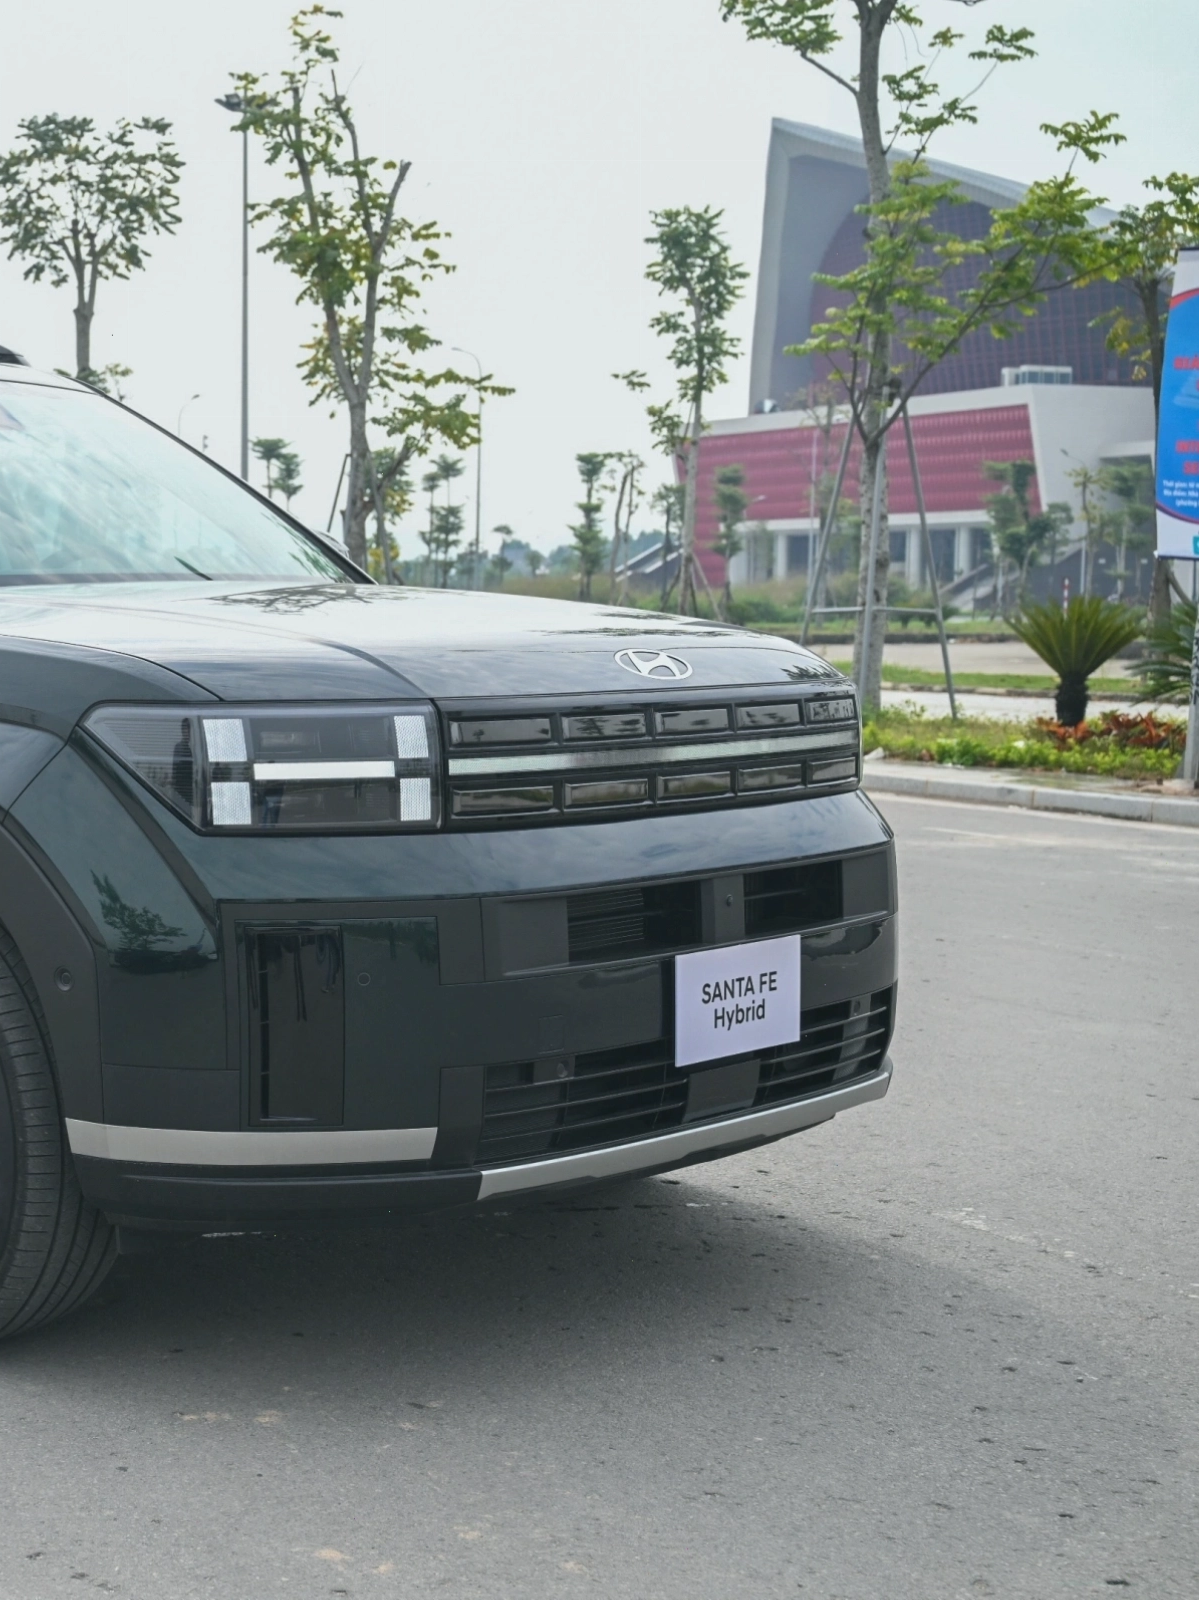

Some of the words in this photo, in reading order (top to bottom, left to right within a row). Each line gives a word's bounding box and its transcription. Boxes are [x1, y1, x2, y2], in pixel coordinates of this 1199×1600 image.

[701, 975, 755, 1004] SANTA
[759, 971, 778, 993] FE
[713, 998, 766, 1031] Hybrid
